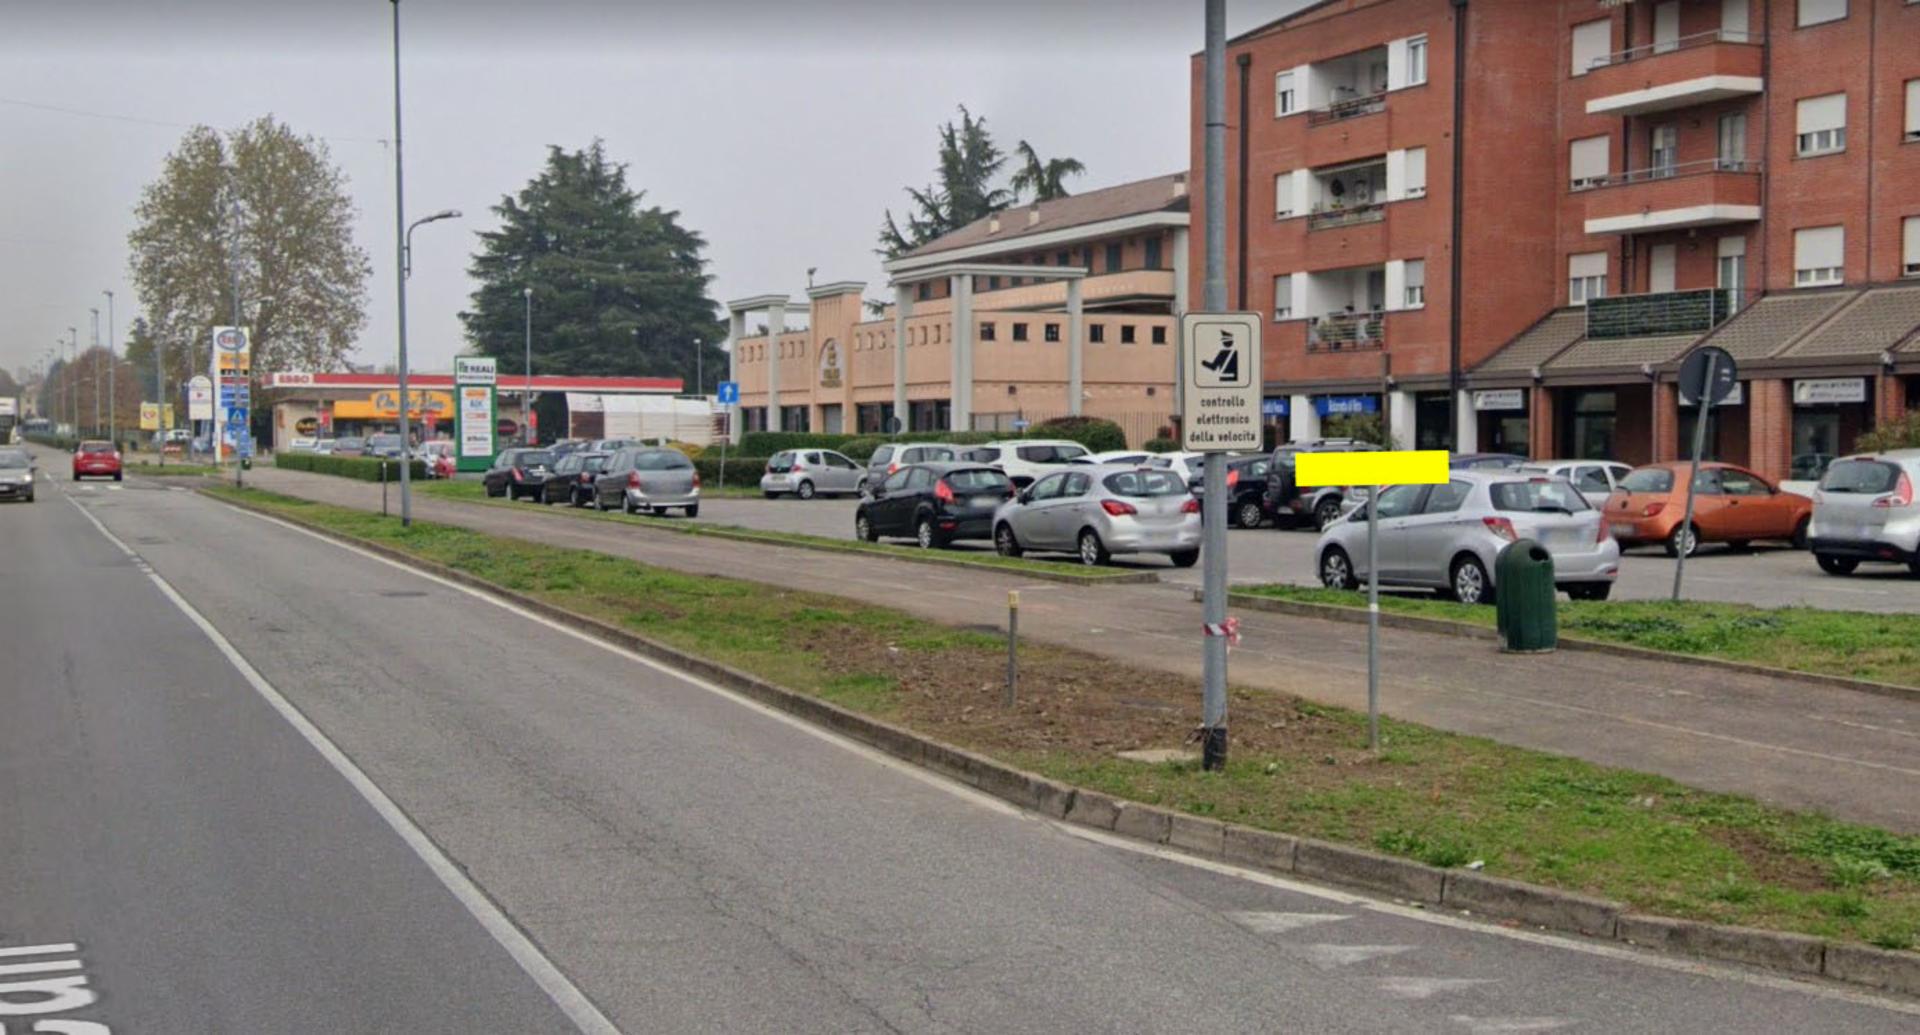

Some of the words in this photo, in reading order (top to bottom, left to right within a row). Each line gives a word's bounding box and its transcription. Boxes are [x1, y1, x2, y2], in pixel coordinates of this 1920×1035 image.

[1200, 396, 1245, 407] controllo
[1196, 413, 1250, 424] elettronico
[1190, 431, 1214, 442] della
